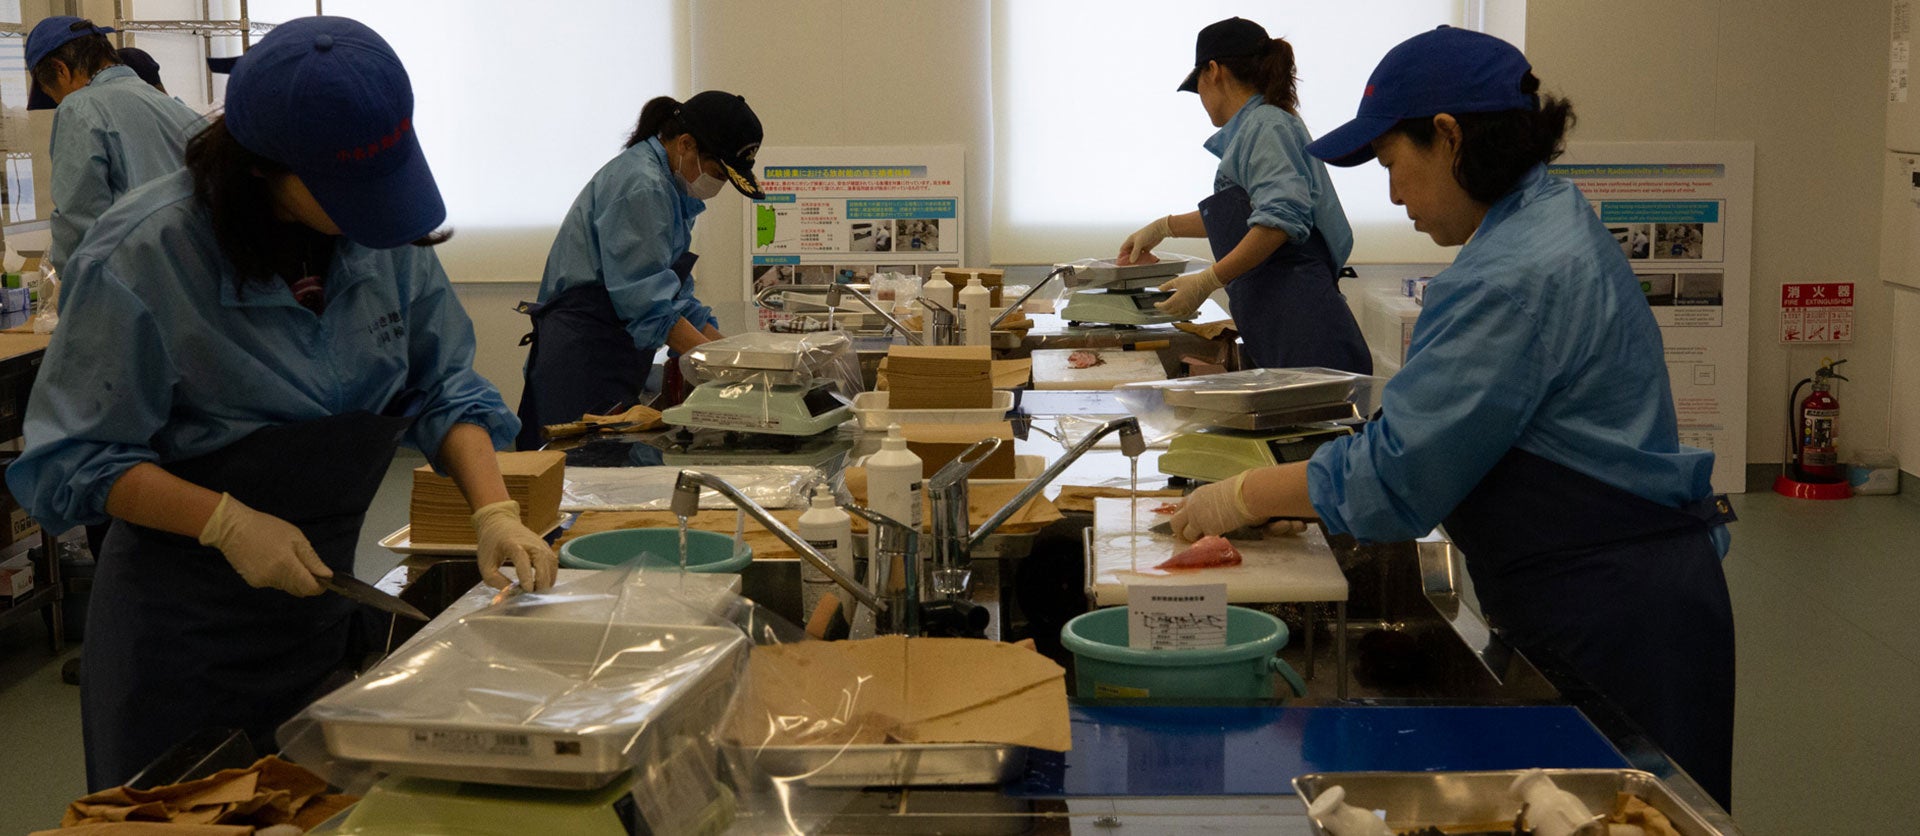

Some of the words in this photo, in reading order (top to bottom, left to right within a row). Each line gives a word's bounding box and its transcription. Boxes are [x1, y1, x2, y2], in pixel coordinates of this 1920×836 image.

[1570, 168, 1595, 177] System
[1608, 168, 1652, 177] Radioactivity
[1787, 285, 1850, 298] 消火器
